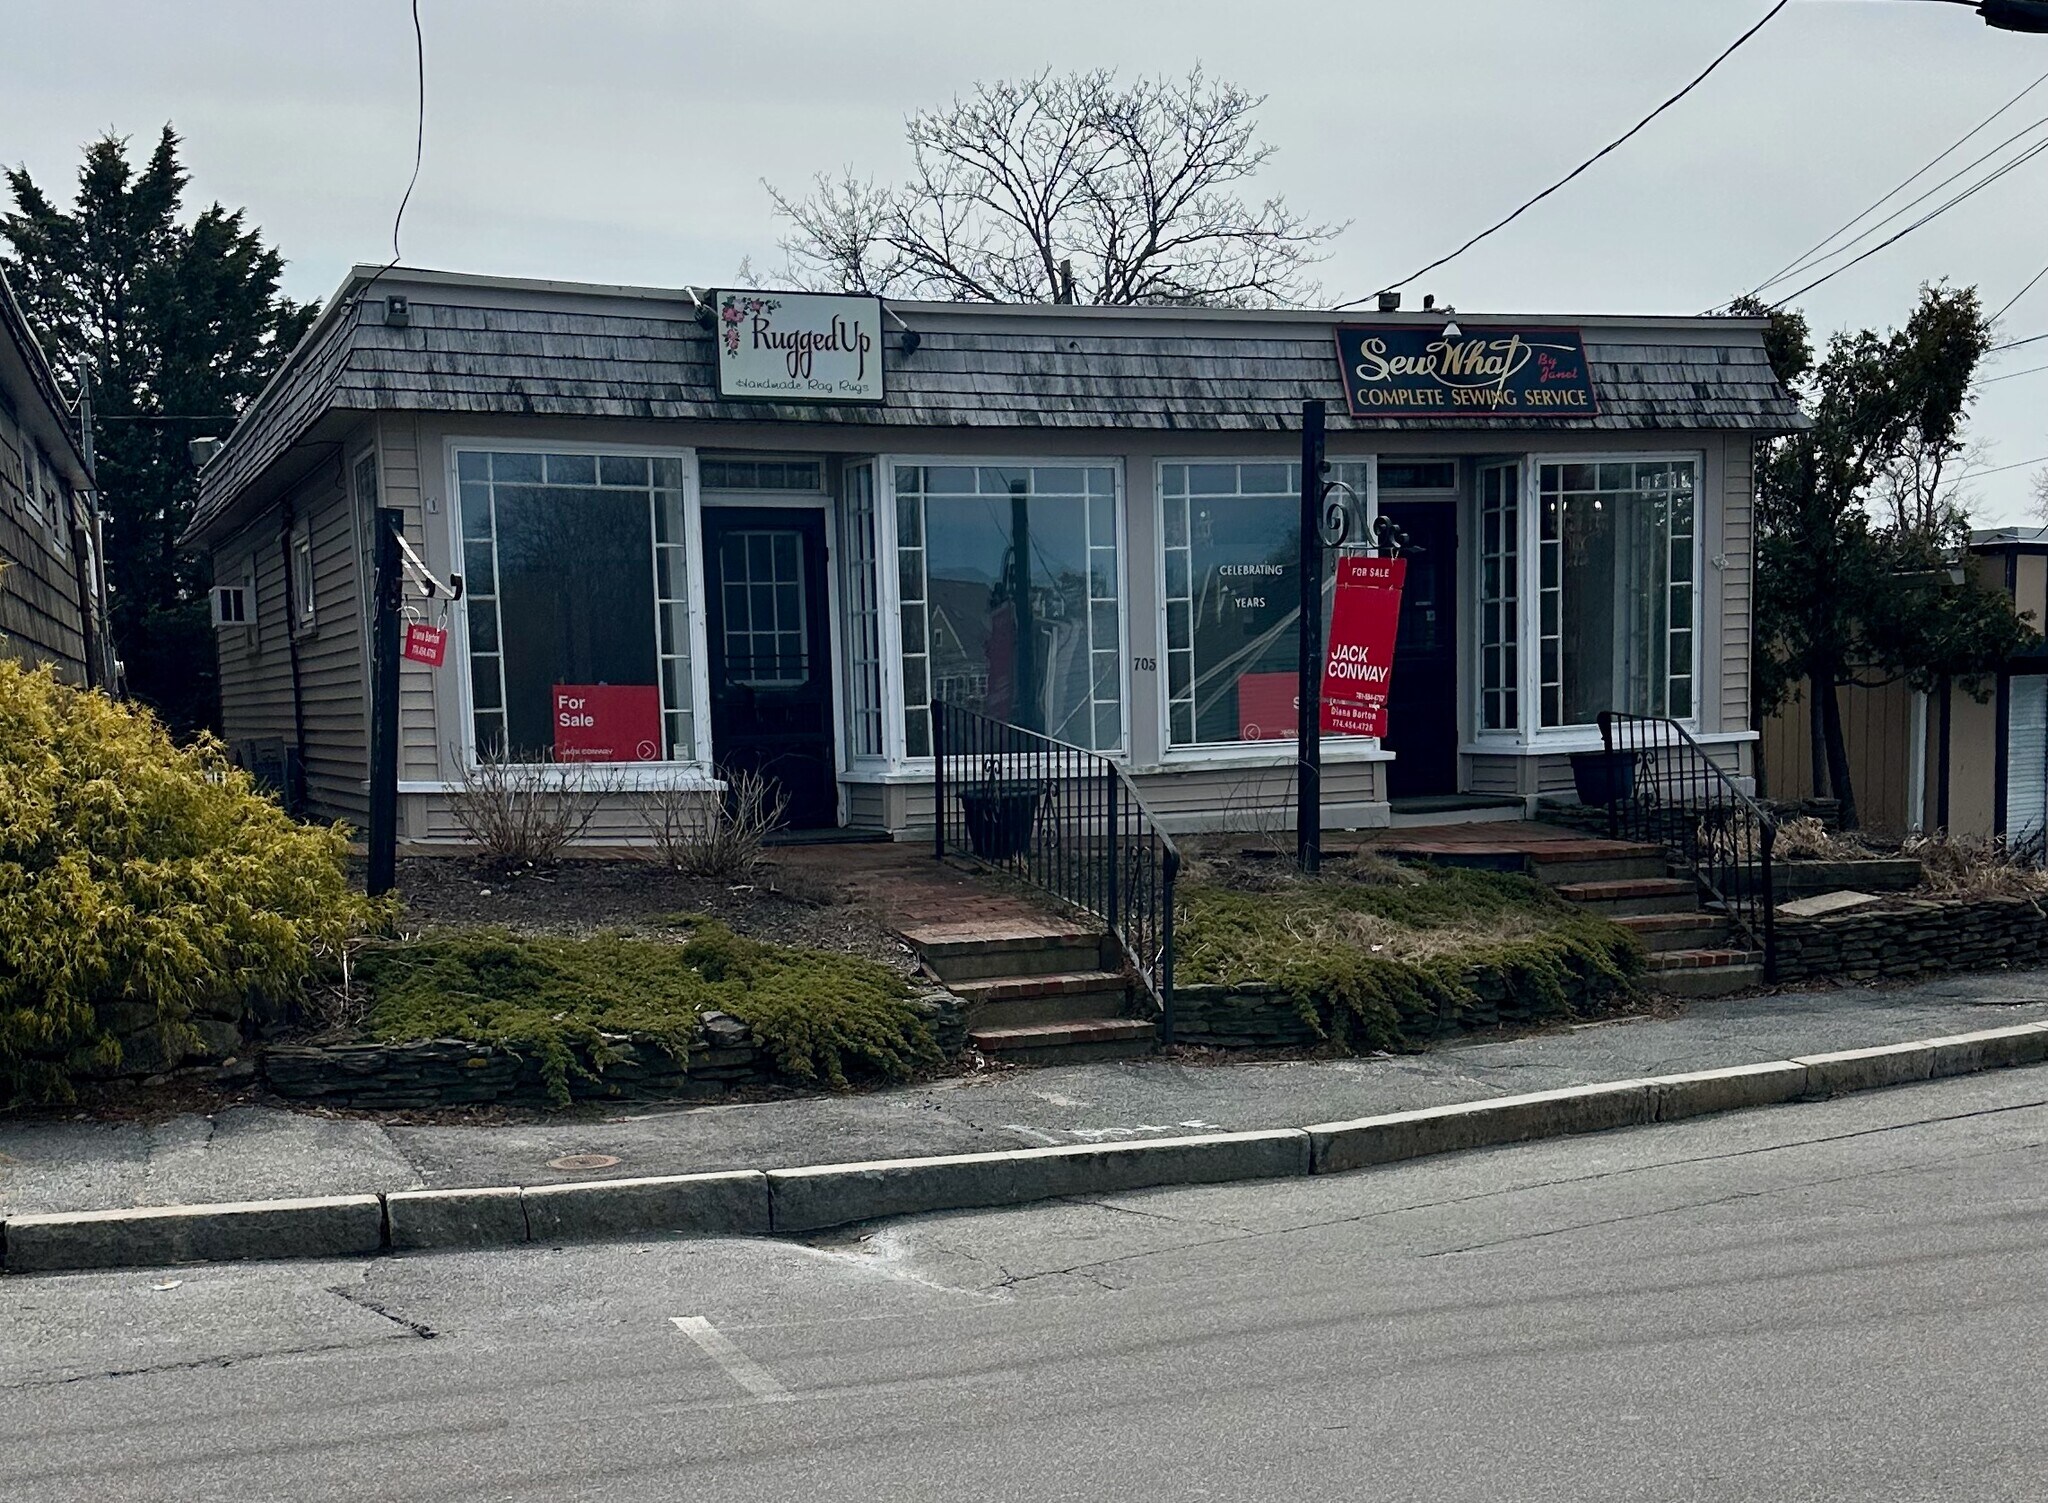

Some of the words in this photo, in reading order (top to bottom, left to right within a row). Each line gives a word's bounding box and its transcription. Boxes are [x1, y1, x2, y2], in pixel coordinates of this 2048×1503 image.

[1356, 337, 1436, 382] Sew
[1426, 334, 1532, 394] What
[1538, 353, 1557, 370] By
[1540, 366, 1578, 383] Janet
[735, 378, 802, 391] Handmade
[807, 379, 833, 393] Rag
[838, 379, 870, 395] Rugs
[1357, 388, 1445, 406] COMPLETE
[1451, 389, 1517, 406] SEWING
[1525, 389, 1589, 406] SERVICE
[1219, 564, 1283, 577] CELEBRATING
[1351, 567, 1368, 578] FOR
[1369, 567, 1390, 579] SALE
[1234, 597, 1266, 609] YEARS
[1331, 644, 1369, 663] JACK
[1328, 661, 1389, 683] CONWAY
[558, 695, 585, 709] For
[559, 712, 594, 727] Sale
